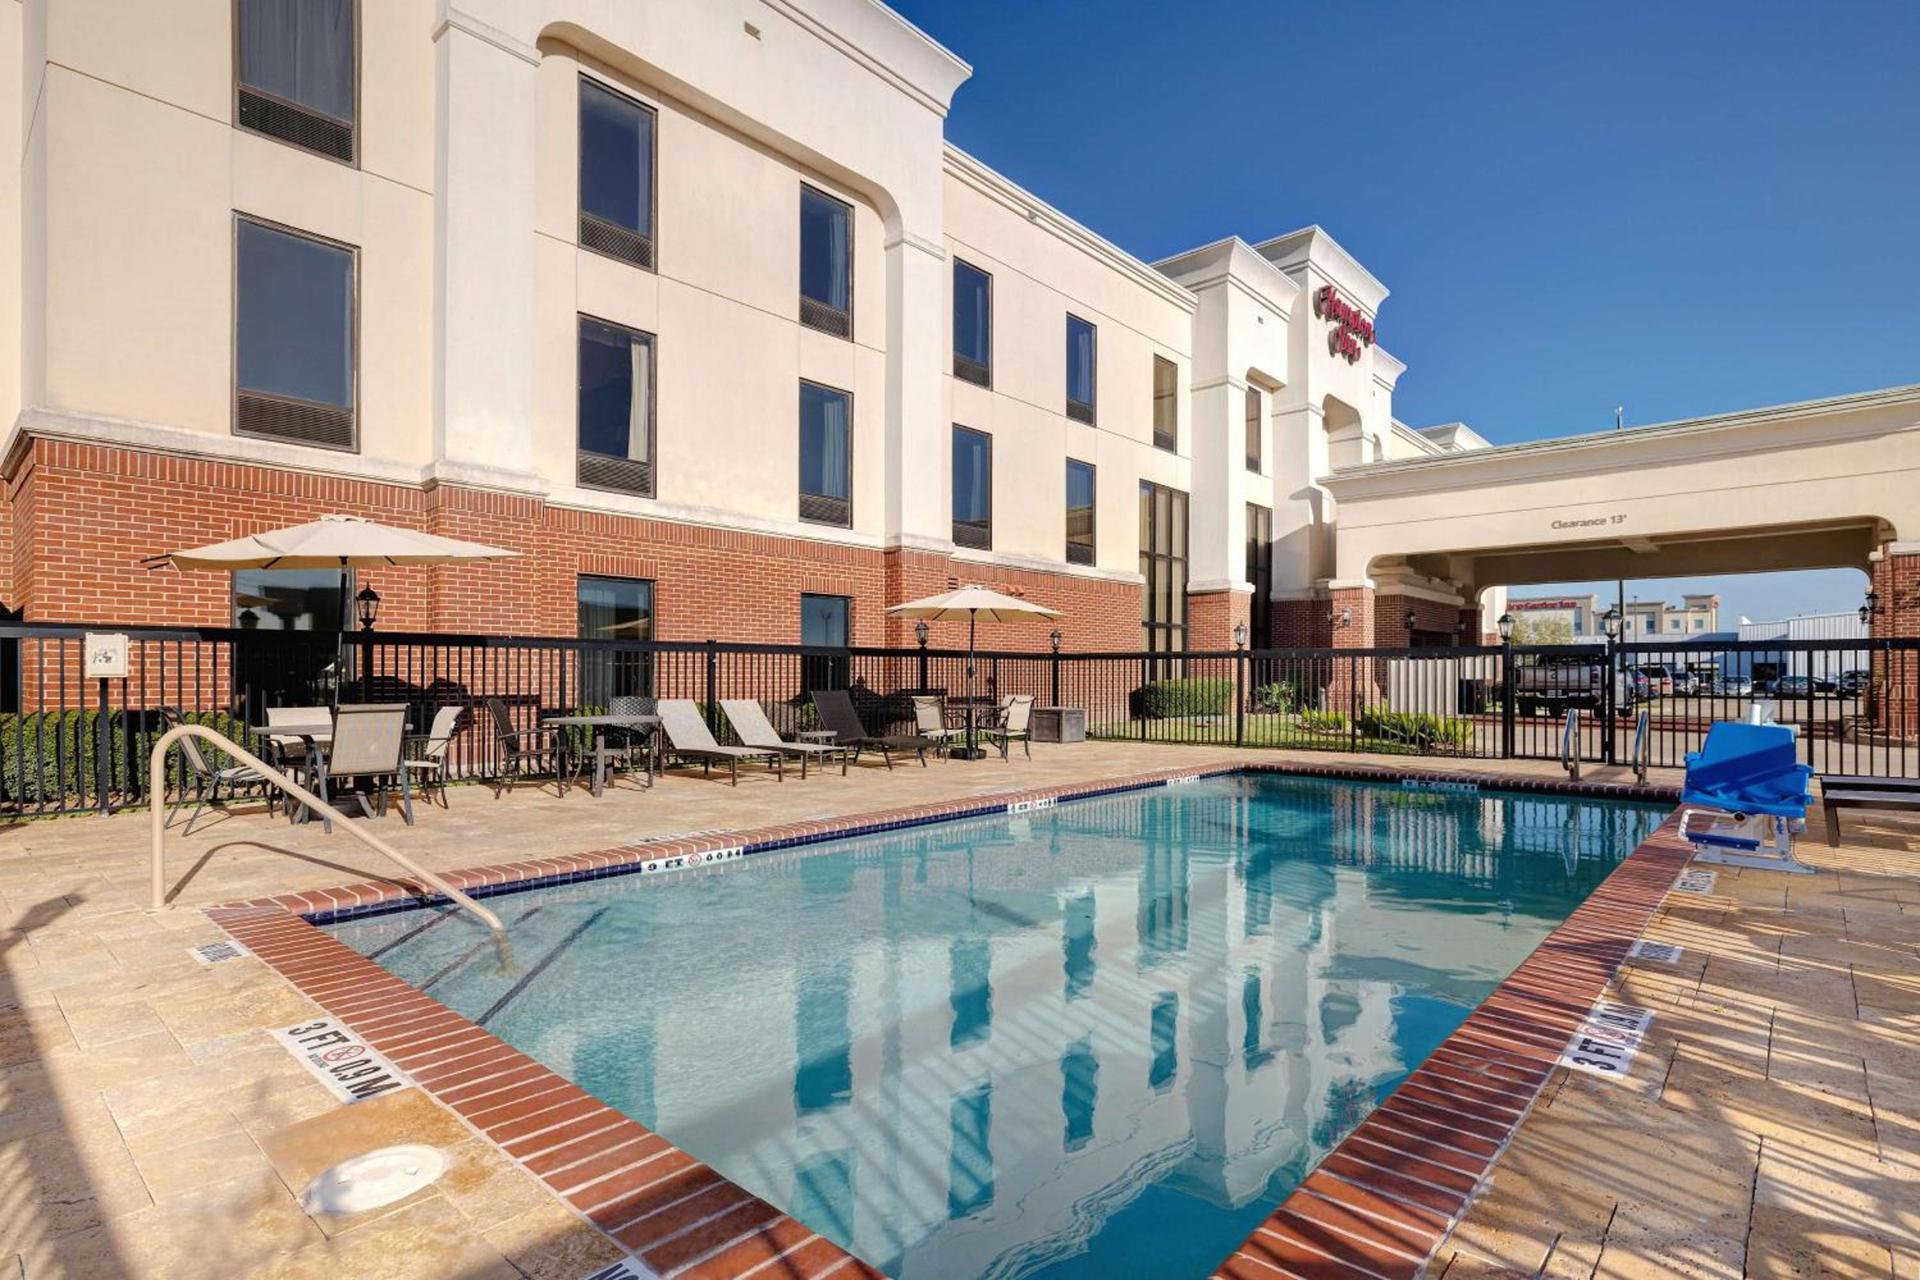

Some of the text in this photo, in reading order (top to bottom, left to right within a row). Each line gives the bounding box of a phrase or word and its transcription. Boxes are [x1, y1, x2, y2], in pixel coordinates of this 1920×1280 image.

[1551, 519, 1607, 530] Clearance
[297, 1030, 351, 1051] FT
[1577, 1037, 1626, 1060] FT
